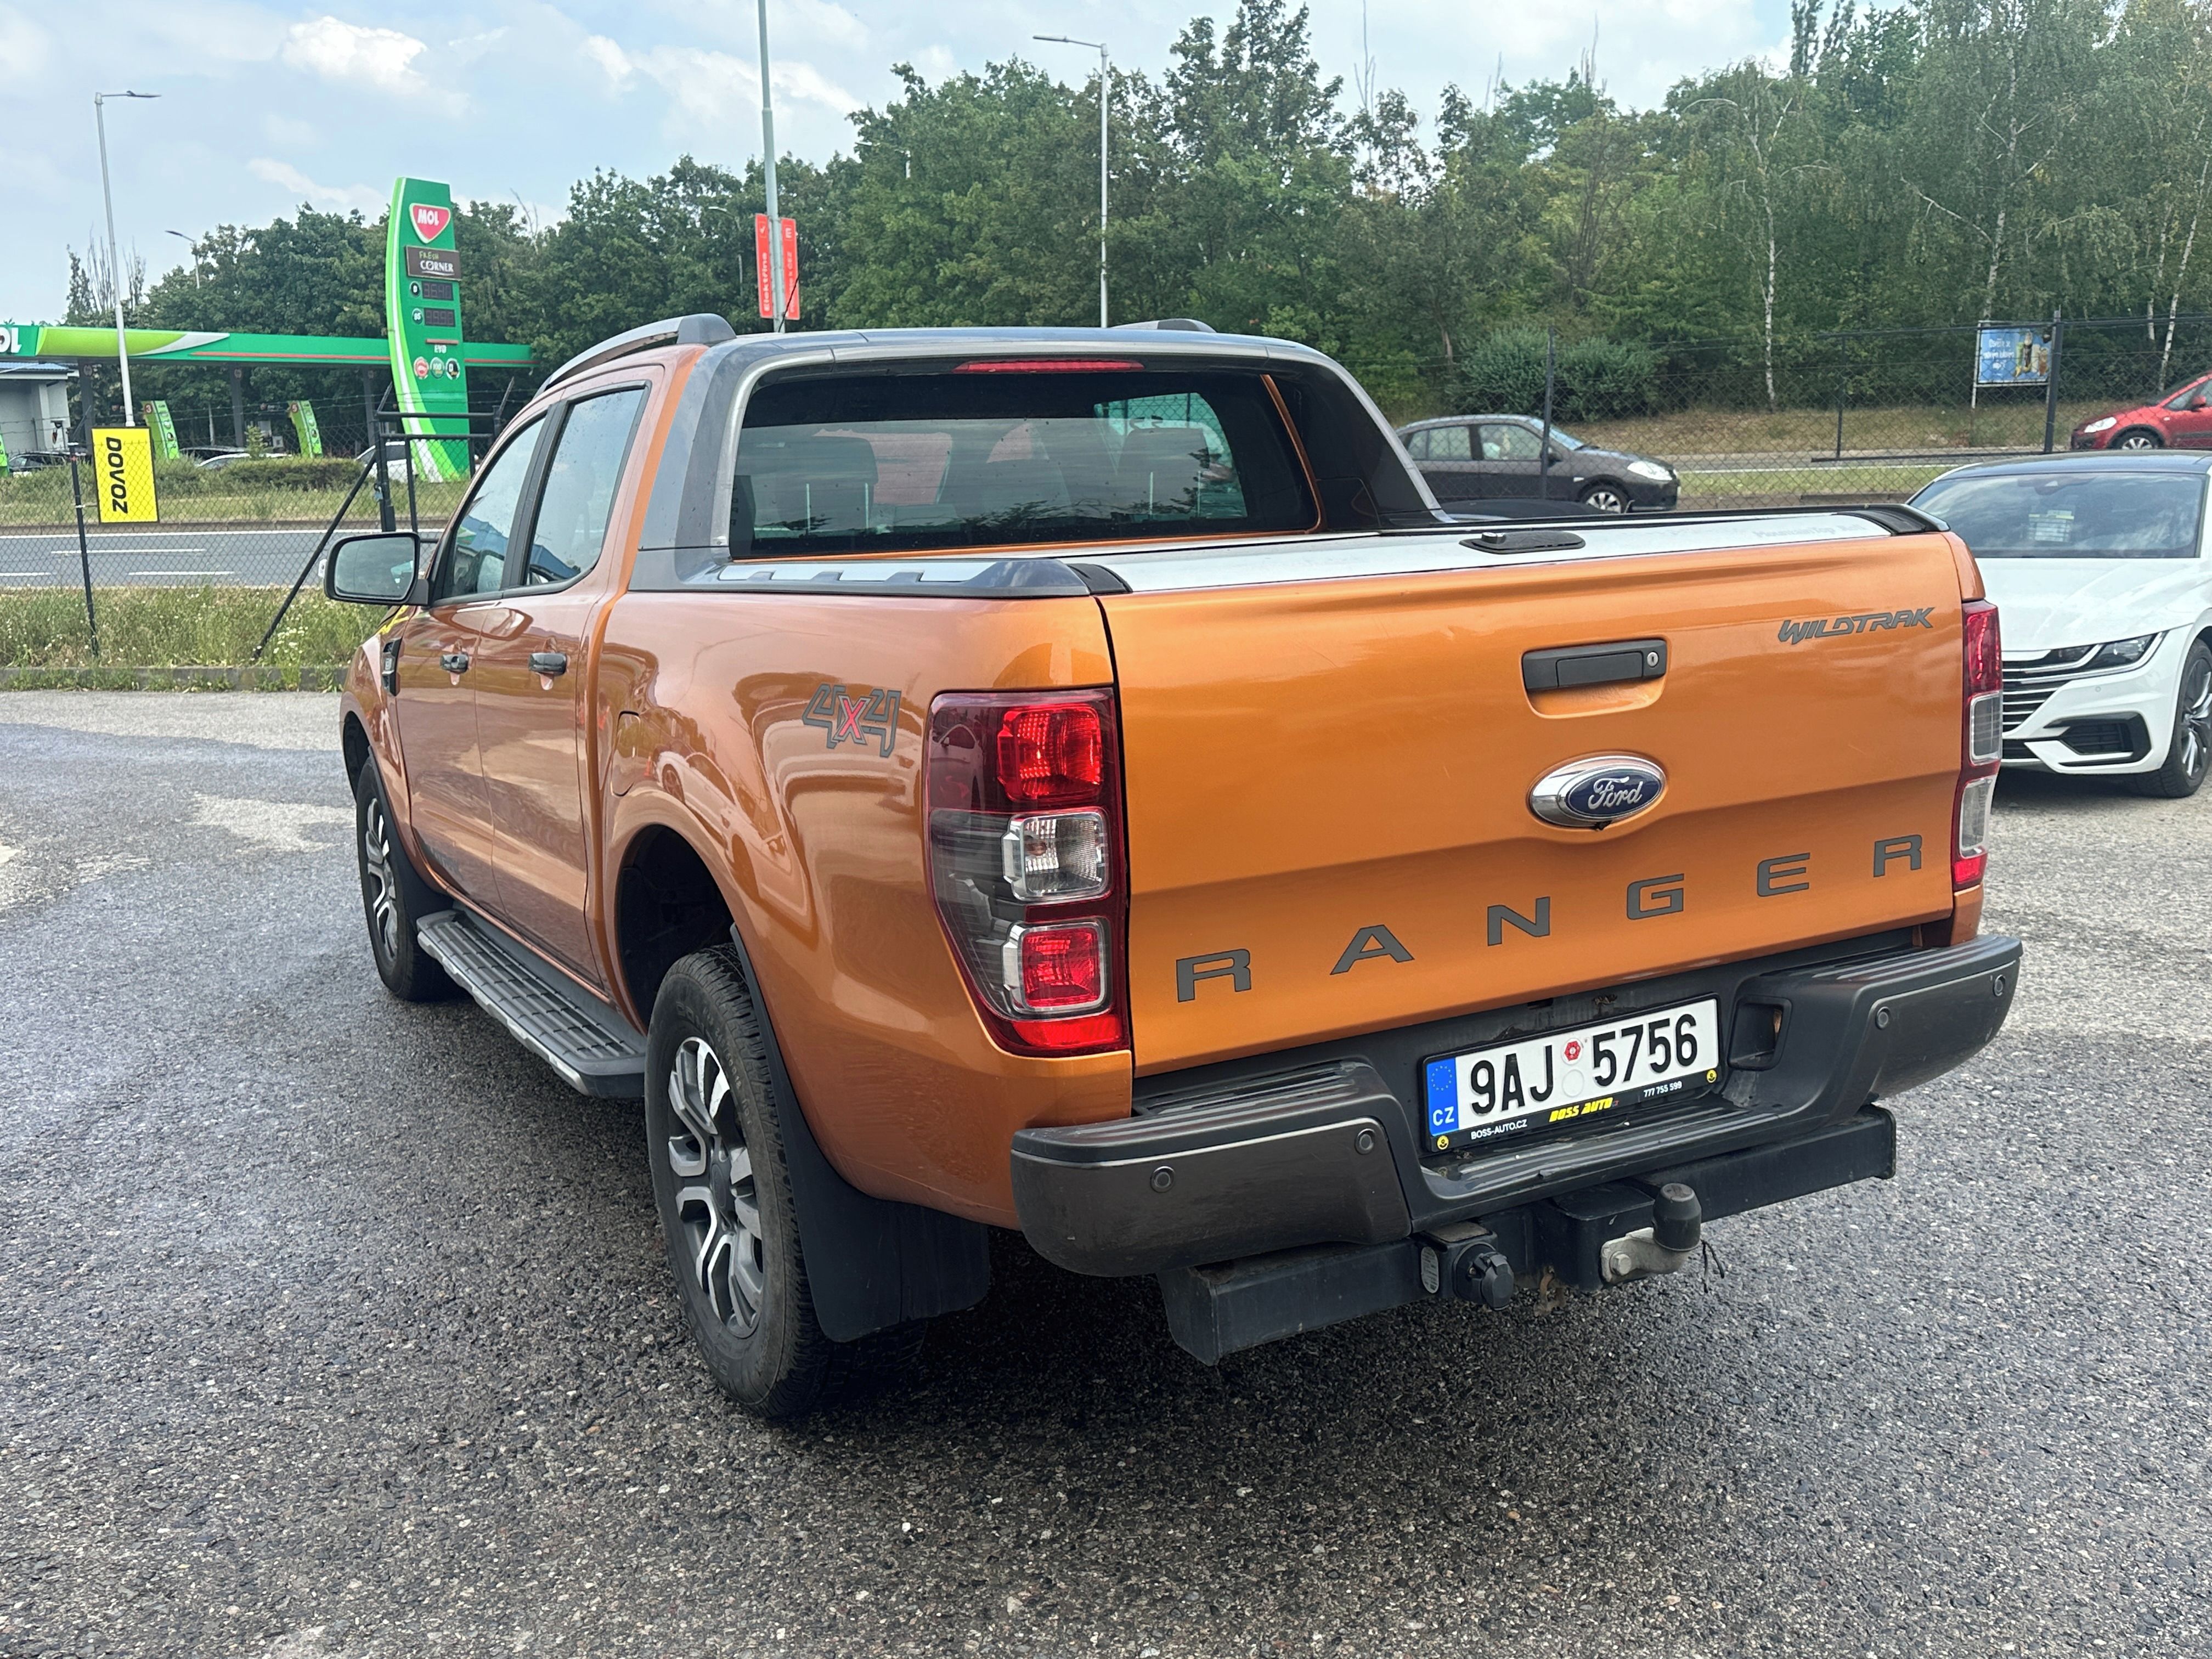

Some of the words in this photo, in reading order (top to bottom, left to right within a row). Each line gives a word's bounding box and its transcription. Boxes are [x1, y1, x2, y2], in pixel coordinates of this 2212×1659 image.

[417, 208, 439, 226] MOL
[419, 251, 439, 260] FRESH
[420, 261, 454, 273] CORNER
[106, 437, 128, 514] DOVOZ
[1778, 607, 1935, 645] WILDTRAK
[1588, 776, 1644, 809] Ford
[1175, 834, 1922, 1002] RANGER
[1470, 1045, 1553, 1115] 9AJ
[1593, 1014, 1698, 1087] 5756
[1644, 1087, 1655, 1097] 777
[1656, 1084, 1669, 1094] 755
[1669, 1081, 1683, 1091] 599
[1432, 1106, 1455, 1126] CZ
[1549, 1105, 1579, 1122] BOSS
[1581, 1097, 1613, 1115] AUTO
[1471, 1119, 1527, 1139] BOSS-AUTO.CZ
